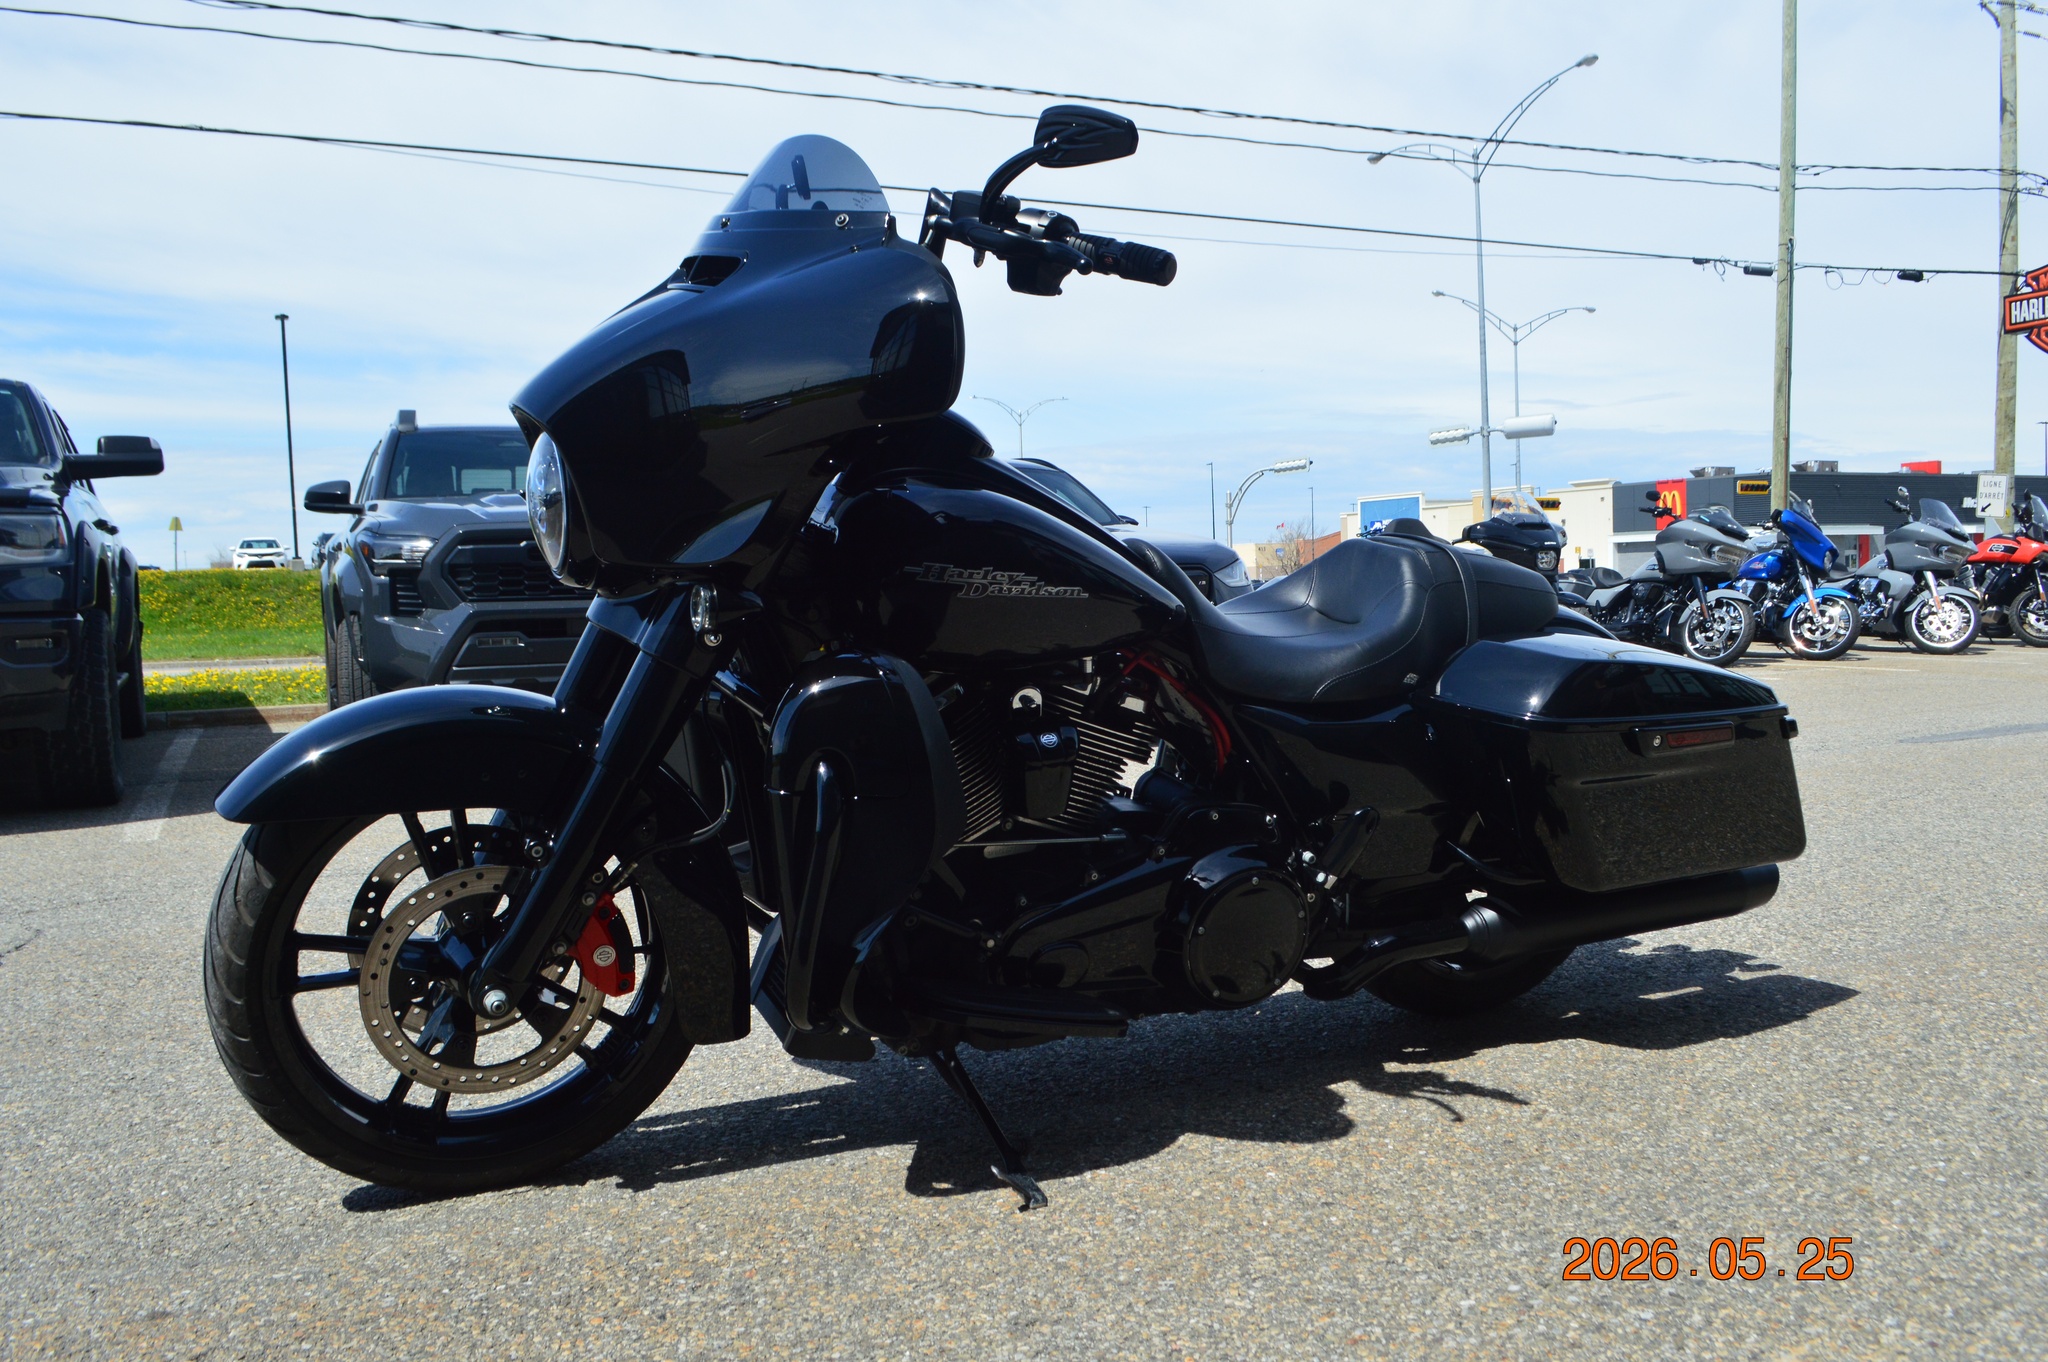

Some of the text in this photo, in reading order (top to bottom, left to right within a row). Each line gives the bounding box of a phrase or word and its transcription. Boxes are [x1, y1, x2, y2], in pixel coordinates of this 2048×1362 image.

[1983, 480, 2002, 488] LIGNE
[904, 562, 1038, 586] Harley
[957, 580, 1089, 599] Davidson
